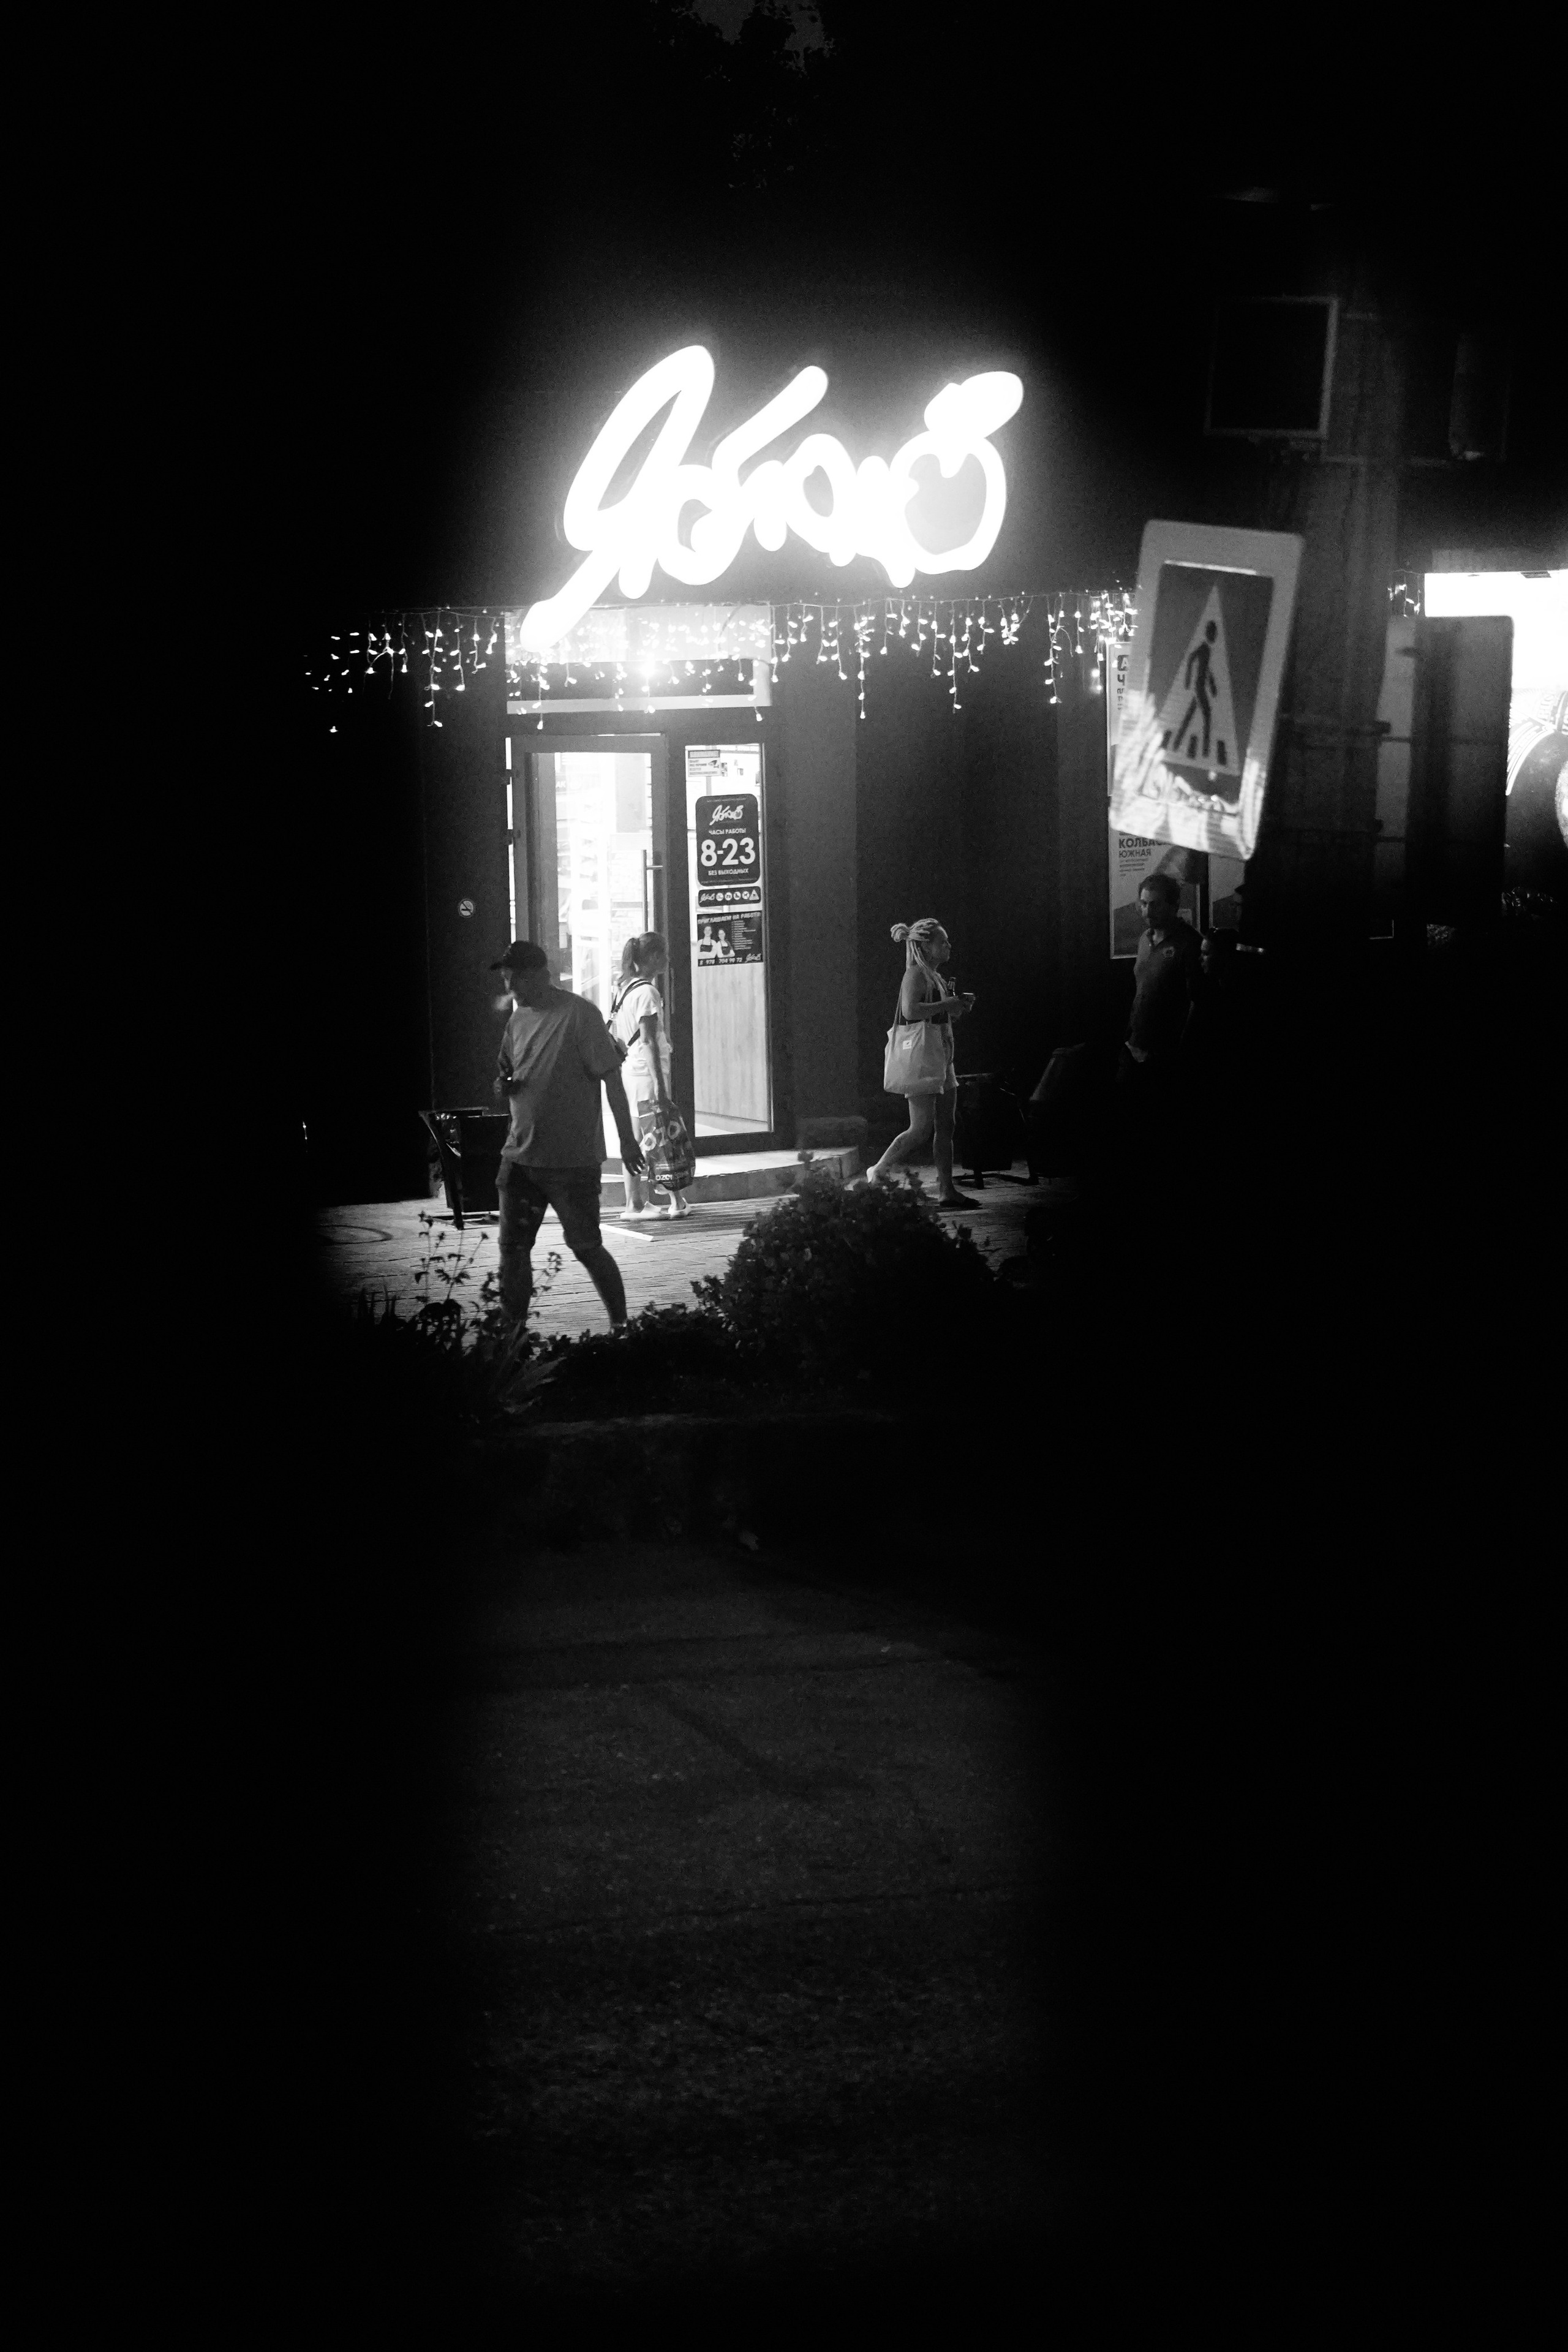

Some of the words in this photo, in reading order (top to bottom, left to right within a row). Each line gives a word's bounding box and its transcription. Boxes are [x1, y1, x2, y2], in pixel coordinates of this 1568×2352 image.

[701, 837, 755, 867] 8-23
[1118, 848, 1152, 858] ЮЖНАЯ
[697, 915, 732, 924] ПРИГЛАШАЕМ
